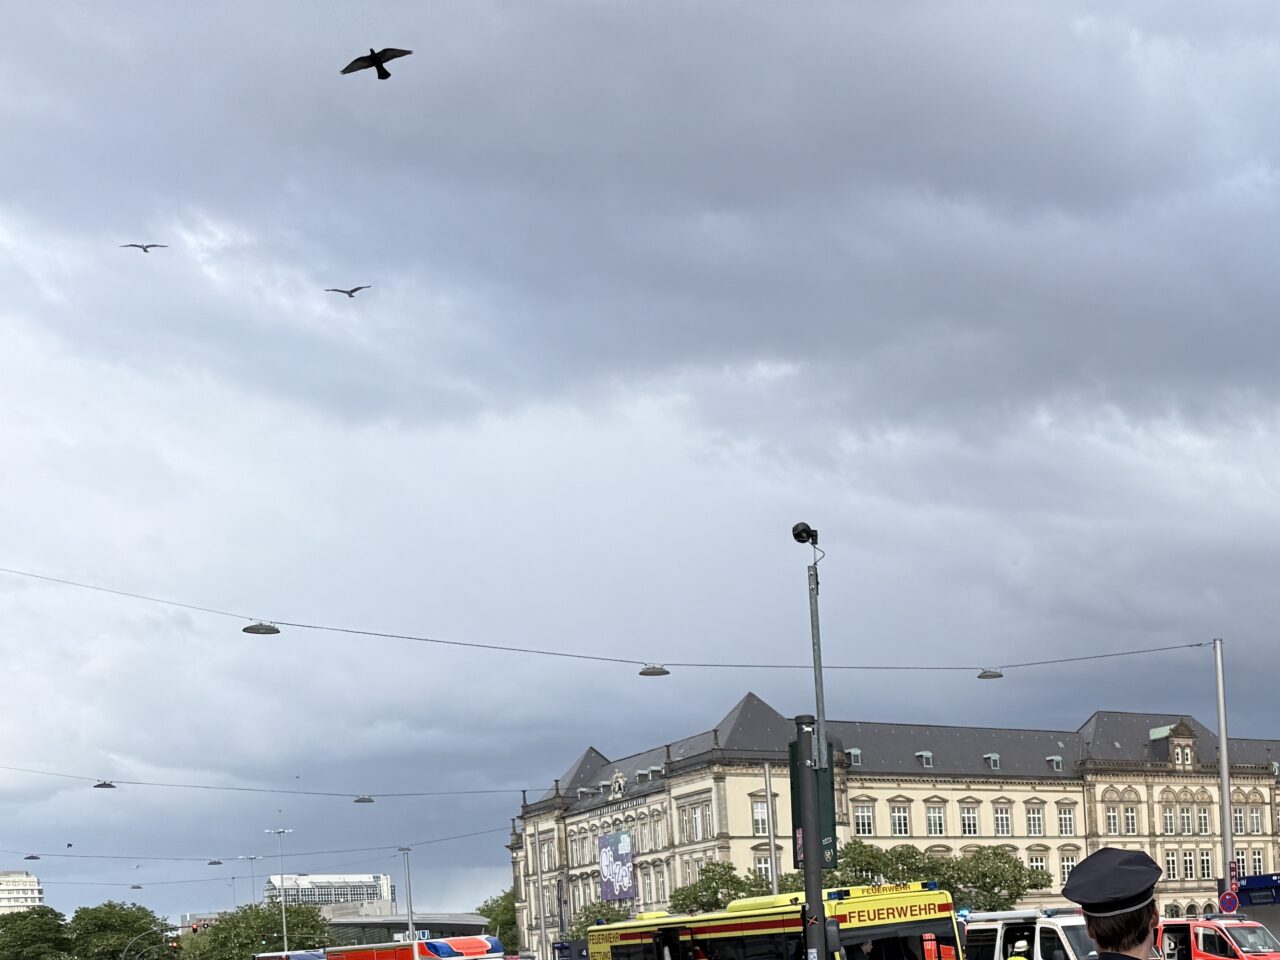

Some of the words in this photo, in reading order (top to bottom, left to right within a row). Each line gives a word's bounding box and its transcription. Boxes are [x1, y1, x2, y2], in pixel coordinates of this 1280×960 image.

[861, 884, 911, 895] FEUERWEHR
[847, 902, 937, 924] FEUERWEHR
[588, 932, 620, 945] FEUERWEHR
[590, 951, 611, 960] RETTUNG
